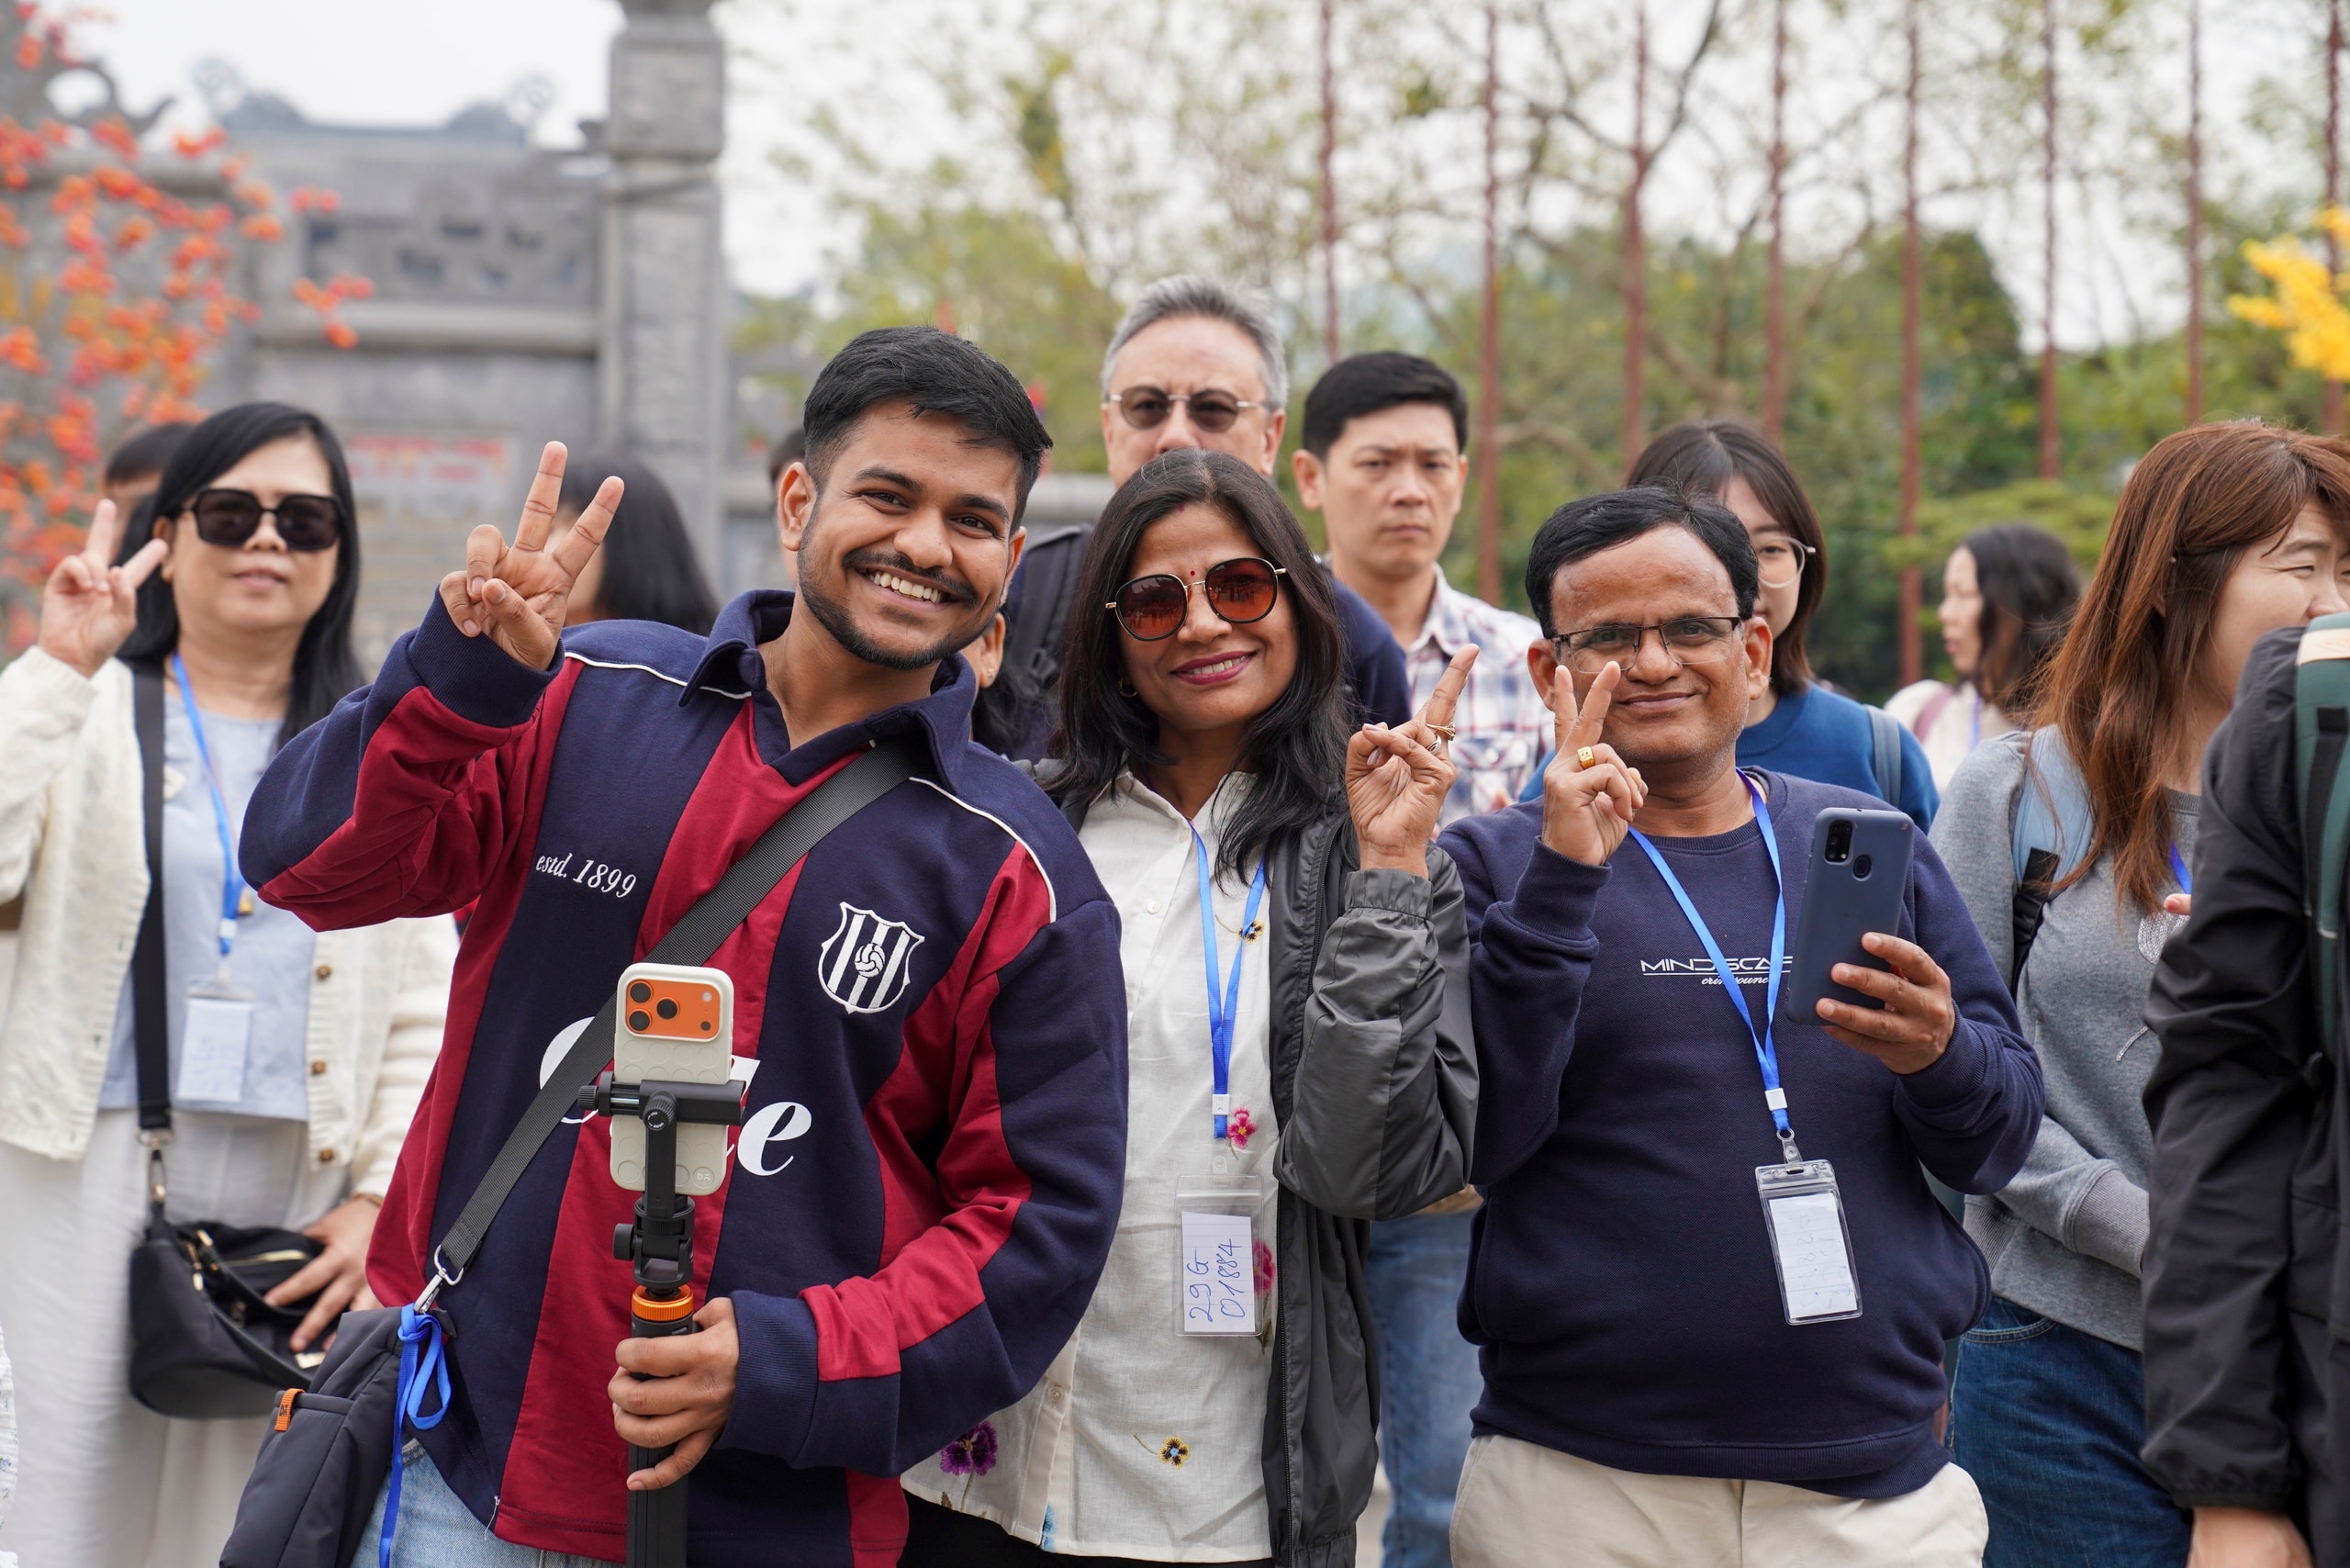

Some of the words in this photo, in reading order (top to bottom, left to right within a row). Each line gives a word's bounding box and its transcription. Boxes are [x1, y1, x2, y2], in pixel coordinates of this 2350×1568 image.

[535, 852, 573, 879] estd.
[572, 859, 637, 898] 1899
[1186, 1248, 1213, 1322] 29G
[1216, 1238, 1246, 1317] 01884
